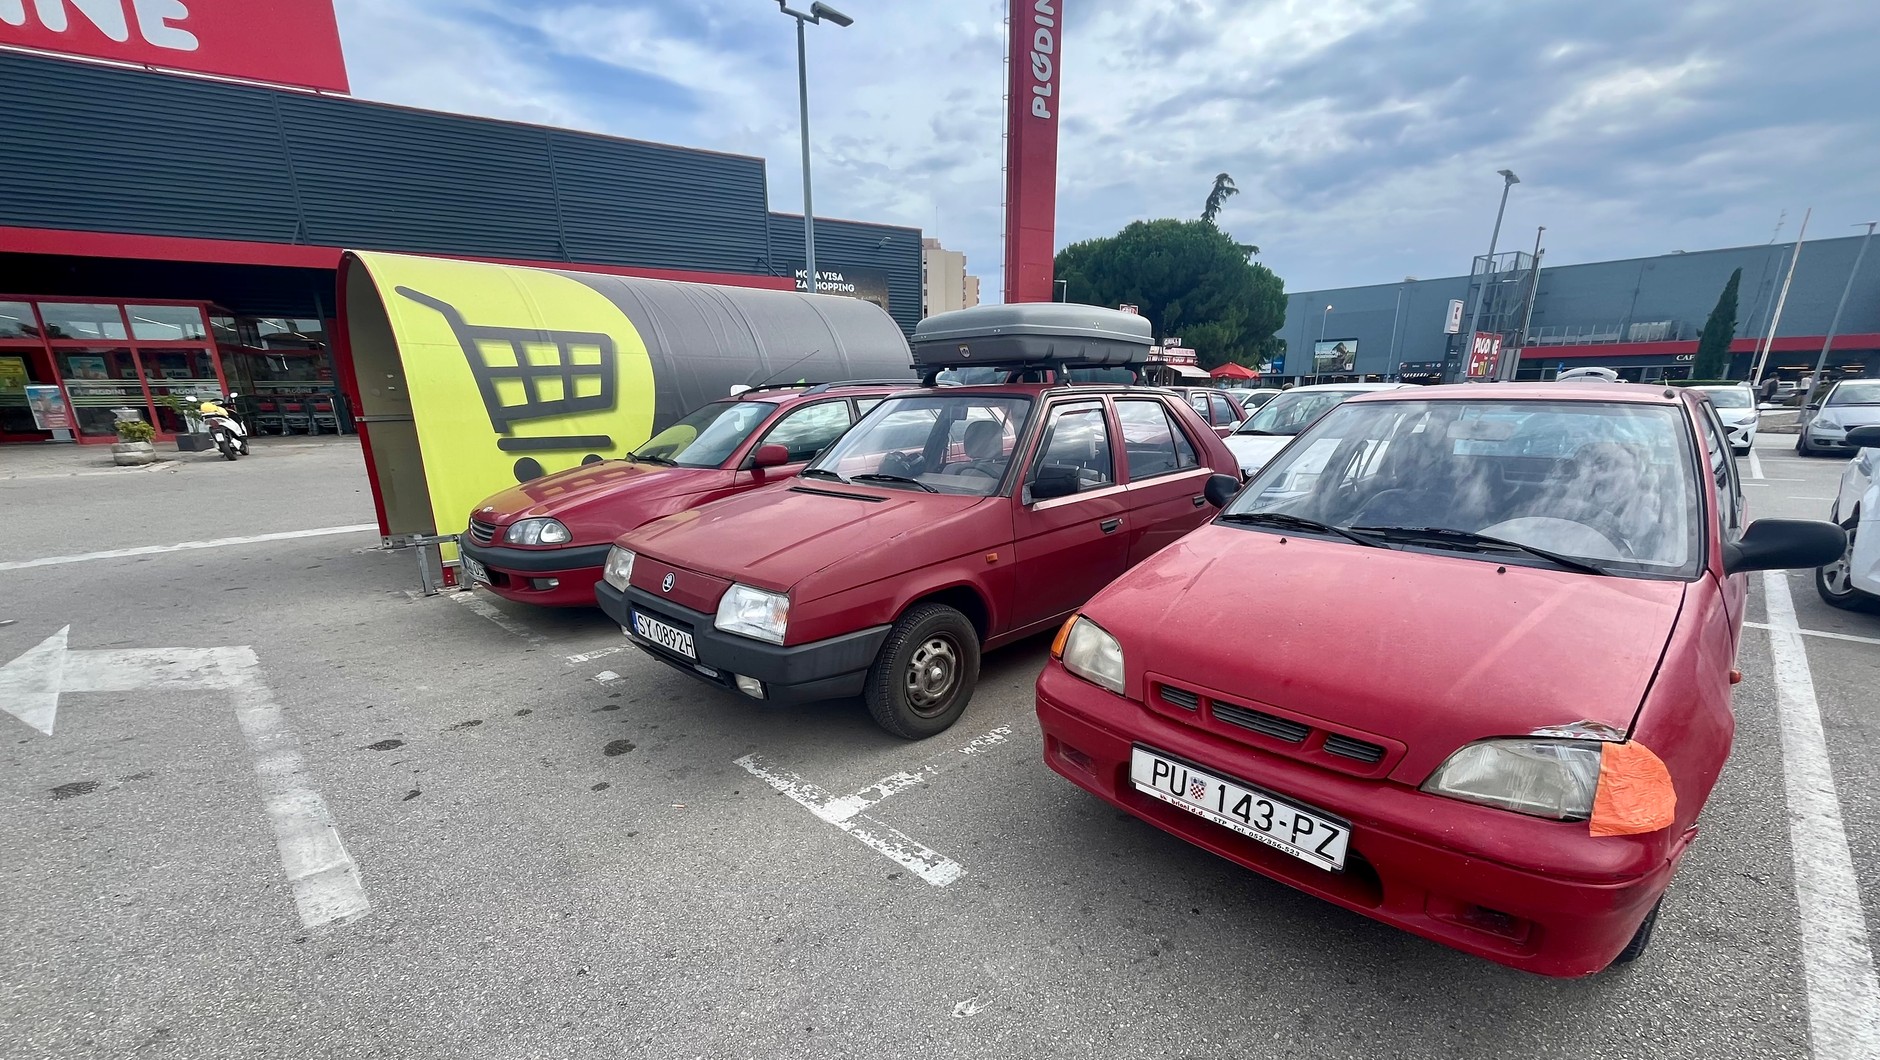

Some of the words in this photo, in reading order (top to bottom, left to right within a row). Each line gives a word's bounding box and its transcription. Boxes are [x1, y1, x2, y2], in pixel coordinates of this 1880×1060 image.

[795, 269, 821, 280] MOA
[822, 271, 844, 282] VISA
[796, 279, 808, 289] ZA
[814, 281, 855, 293] HOPPING
[637, 615, 652, 639] SY
[655, 622, 694, 657] 0892H
[1151, 758, 1188, 797] PU
[1217, 784, 1340, 861] 143-PZ
